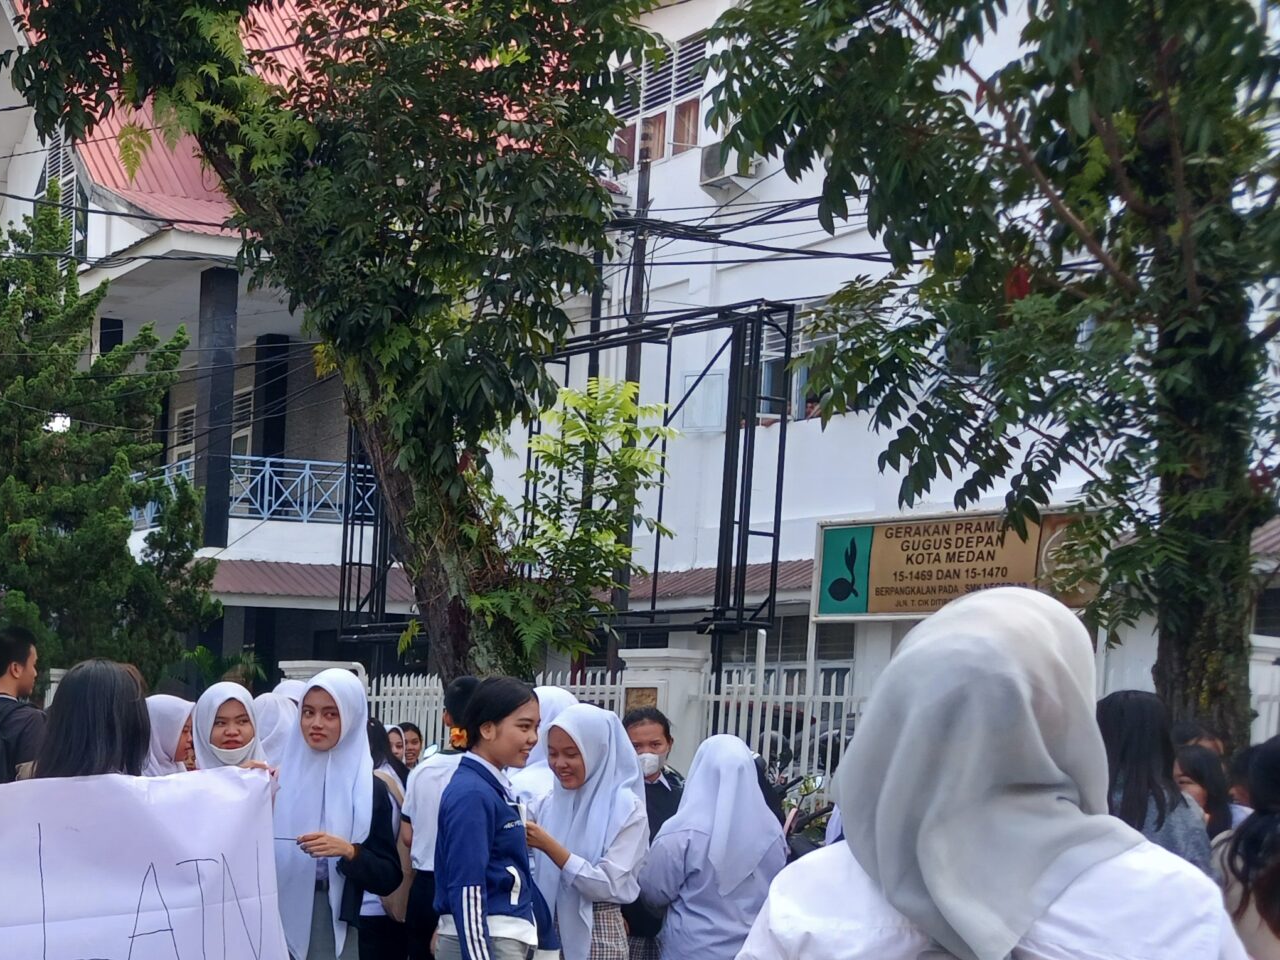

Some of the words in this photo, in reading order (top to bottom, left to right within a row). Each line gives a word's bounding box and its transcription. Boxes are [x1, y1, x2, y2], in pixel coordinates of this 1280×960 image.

[885, 524, 951, 539] GERAKAN
[901, 538, 952, 551] GUGUS
[906, 551, 942, 565] KOTA
[945, 549, 996, 563] MEDAN
[893, 569, 933, 582] 15-1469
[936, 568, 961, 580] DAN
[964, 566, 1008, 579] 15-1470
[875, 585, 937, 597] BERPANGKALAN
[938, 584, 959, 595] PADA
